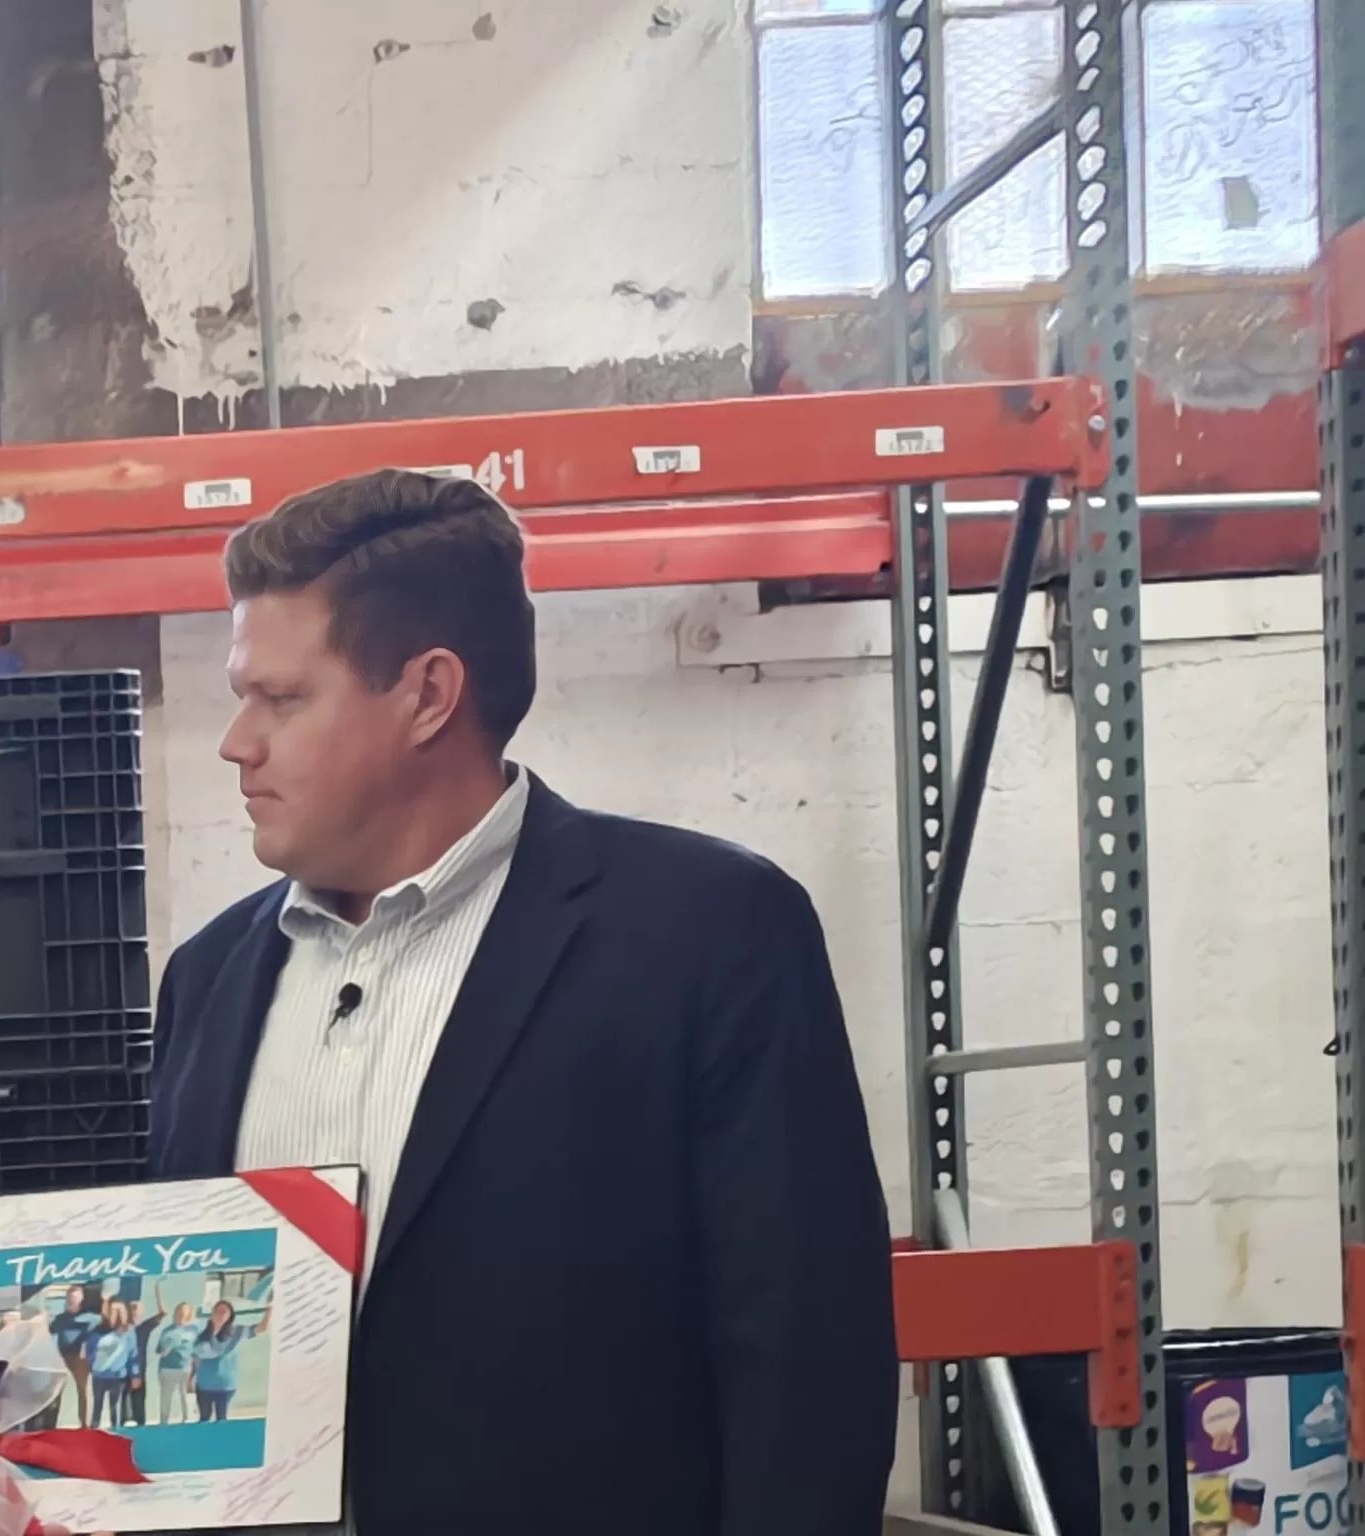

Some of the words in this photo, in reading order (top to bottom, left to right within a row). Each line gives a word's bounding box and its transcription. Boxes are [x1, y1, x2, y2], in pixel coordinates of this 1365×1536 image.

[476, 448, 524, 494] 41
[6, 1245, 148, 1285] Thank
[154, 1237, 229, 1275] You
